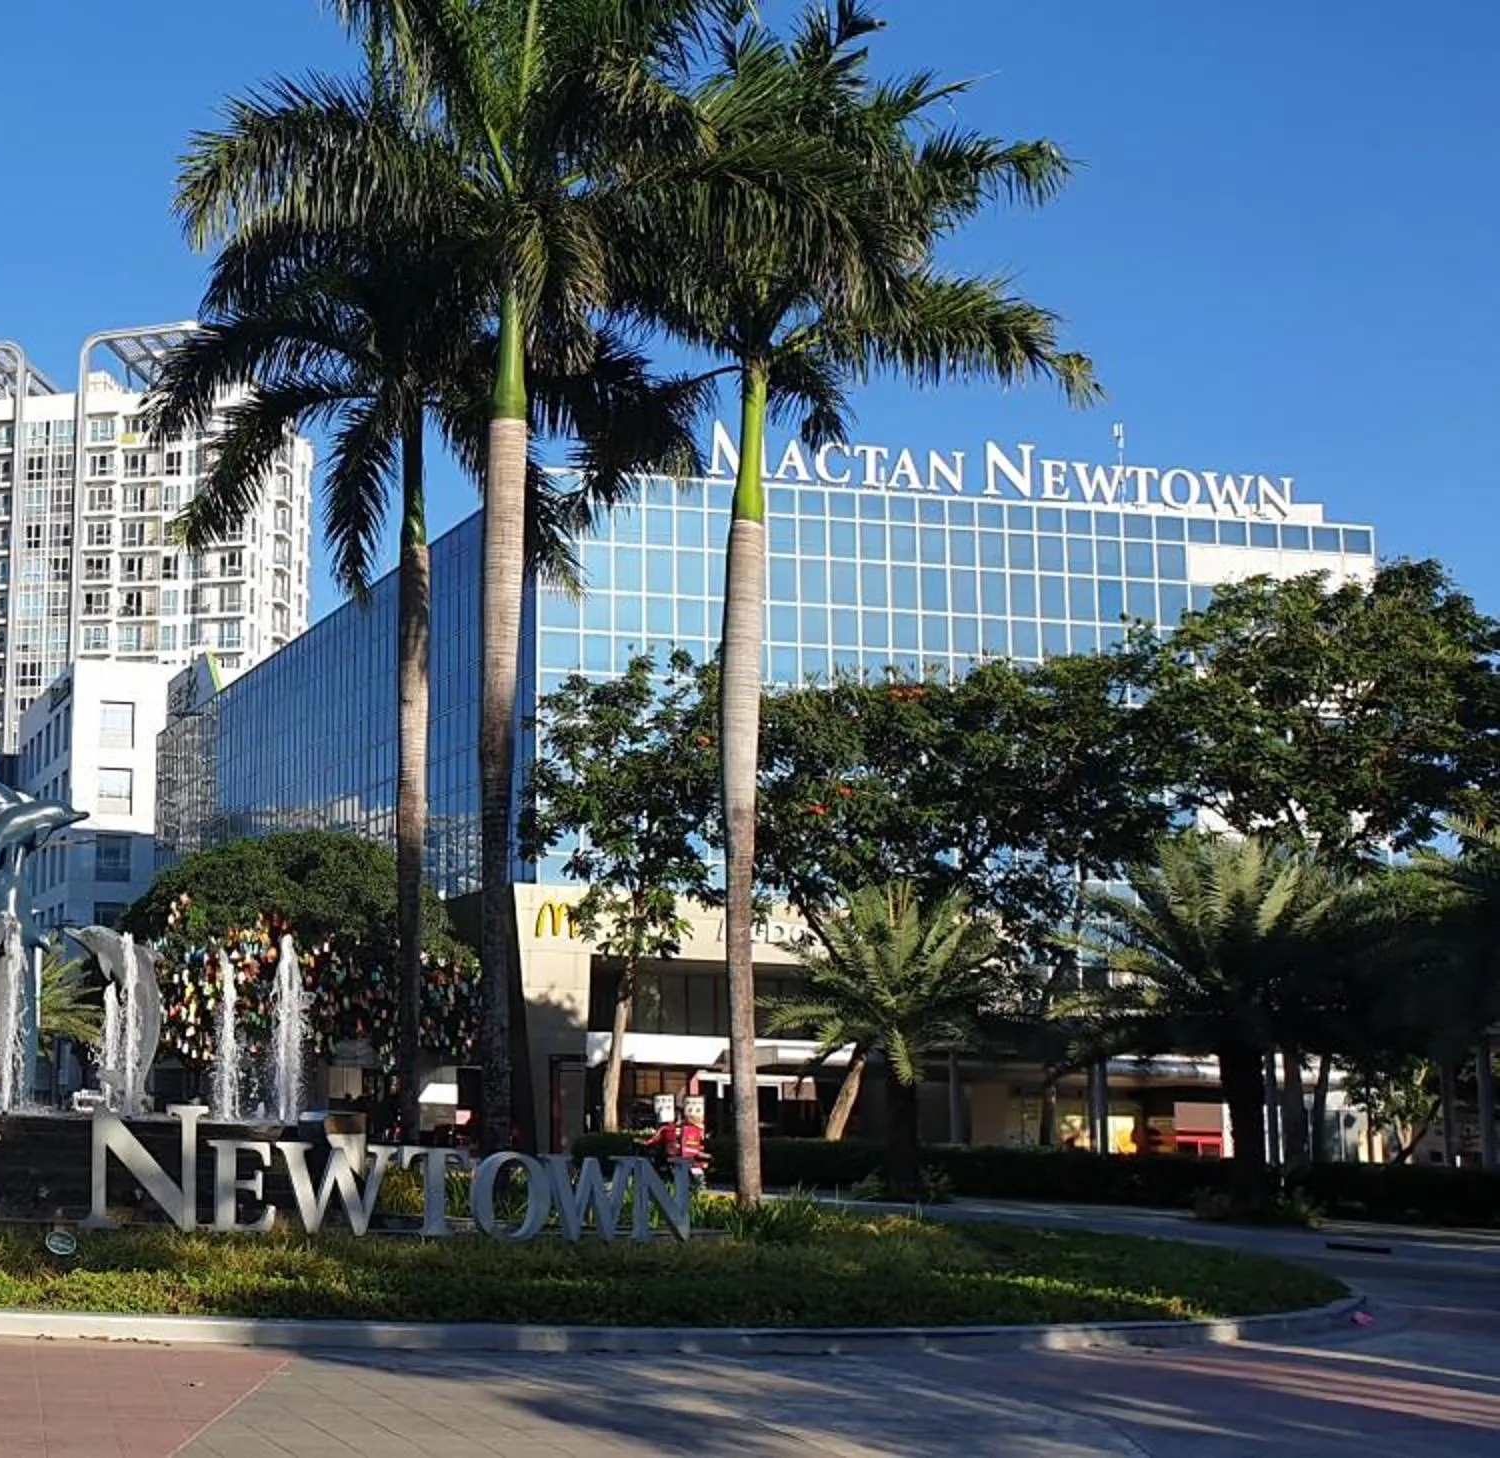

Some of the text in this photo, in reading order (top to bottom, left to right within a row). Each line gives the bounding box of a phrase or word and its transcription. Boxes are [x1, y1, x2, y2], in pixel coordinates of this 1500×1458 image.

[706, 419, 1294, 517] MACTAN NEWTOWN
[78, 1103, 691, 1242] NEWTOWN
